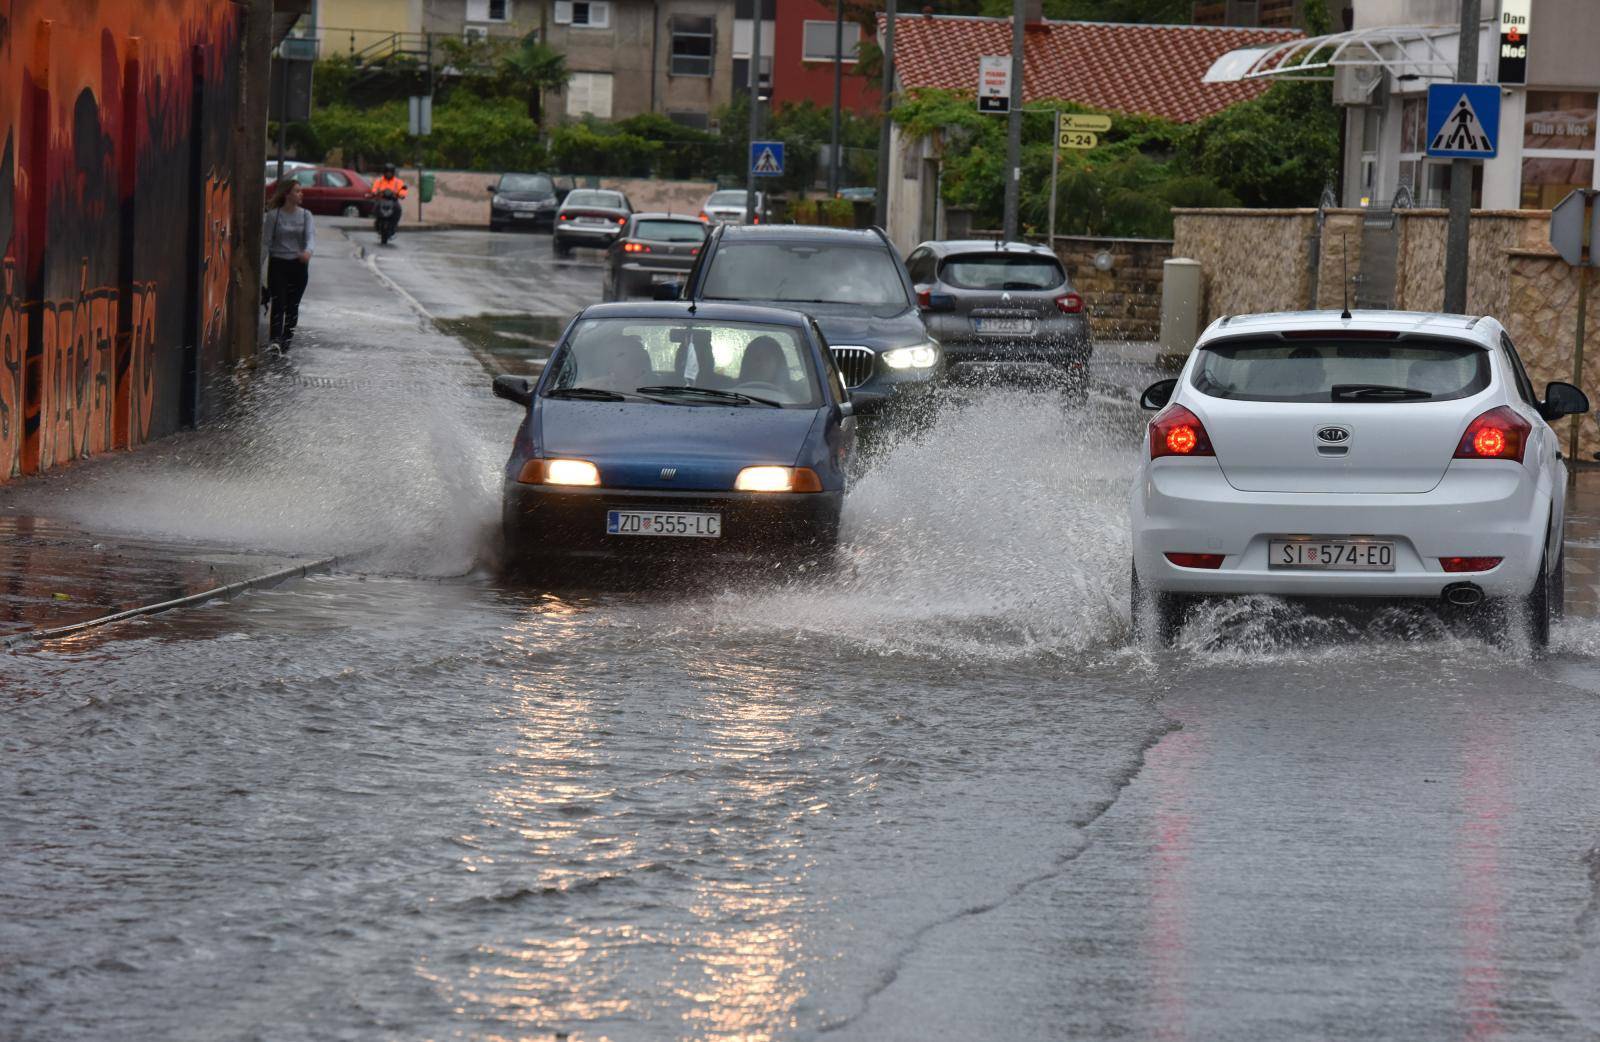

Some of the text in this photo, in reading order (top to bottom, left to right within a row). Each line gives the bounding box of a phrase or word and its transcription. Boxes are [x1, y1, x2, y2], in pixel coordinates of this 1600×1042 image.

[1503, 12, 1526, 25] Dan
[1507, 26, 1520, 41] &
[1532, 121, 1554, 135] Dan
[1061, 134, 1092, 146] 0-24
[620, 514, 717, 535] ZD 555-LC
[1321, 544, 1391, 565] 574-EO
